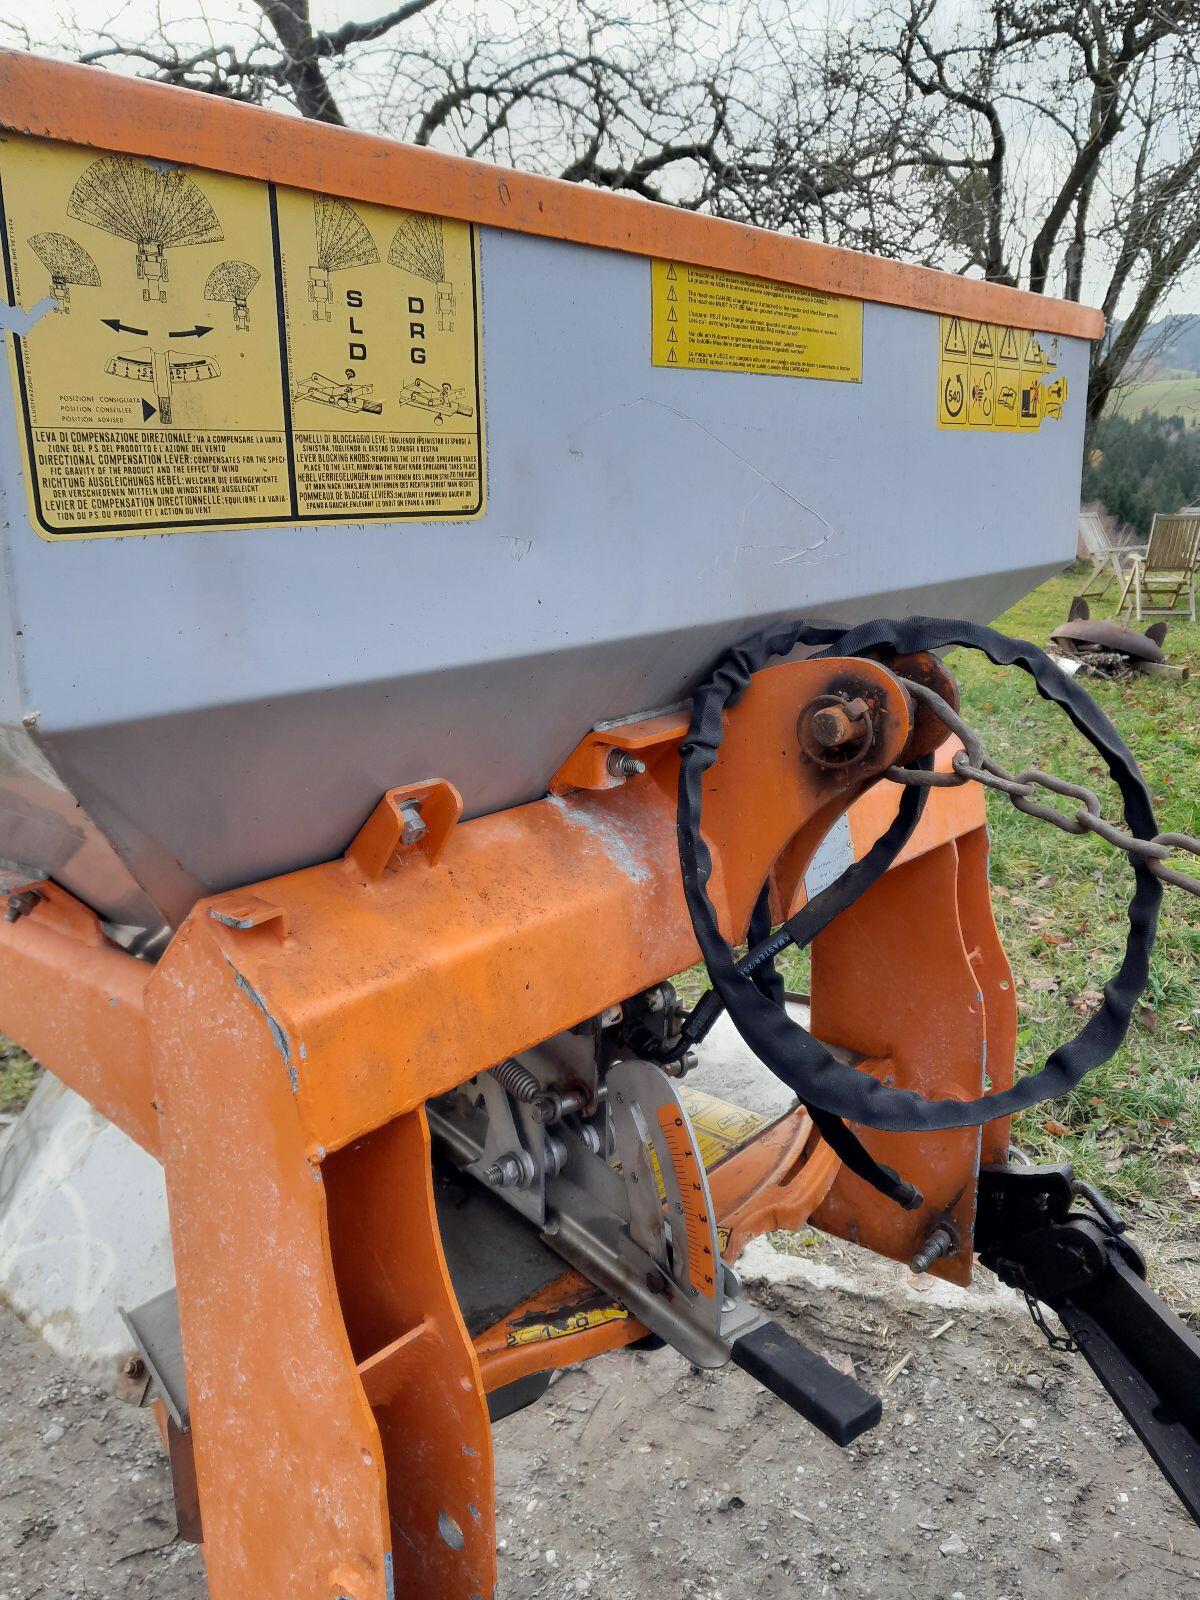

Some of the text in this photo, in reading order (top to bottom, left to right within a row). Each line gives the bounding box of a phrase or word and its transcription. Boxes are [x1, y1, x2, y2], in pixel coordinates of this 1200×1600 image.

[346, 290, 363, 308] S
[408, 296, 425, 314] D
[349, 316, 363, 334] L
[410, 322, 425, 339] R
[349, 342, 367, 361] D
[410, 347, 426, 365] G
[59, 395, 141, 404] POSIZIONE CONSIGLIATA
[947, 389, 961, 405] 540
[60, 405, 132, 414] POSITION CONSEILLEE
[61, 415, 124, 424] POSITION ADVISED
[35, 431, 57, 443] LEVA
[59, 432, 68, 443] DI
[70, 432, 139, 443] COMPENSAZIONE
[212, 436, 254, 444] COMPENSARE
[255, 436, 264, 444] LA
[294, 434, 323, 444] POMELLI
[324, 434, 331, 444] DI
[332, 434, 370, 444] BLOCCAGGIO
[48, 444, 70, 452] ZIONE
[72, 445, 85, 453] DEL
[116, 445, 152, 453] PRODOTTO
[204, 445, 226, 453] VENTO
[38, 454, 96, 466] DIRECTIONAL
[98, 455, 162, 466] COMPENSATION
[194, 456, 241, 464] COMPENSATES
[242, 456, 255, 464] FOR
[256, 456, 267, 464] THE
[296, 453, 317, 463] LEVER
[318, 453, 349, 463] BLOCKING
[50, 465, 239, 475] FIC GRAVITY OF THE PRODUCT AND THE EFFECT OF WIND
[42, 477, 86, 488] RICHTUNG
[88, 476, 155, 488] AUSGLEICHUNGS
[185, 476, 216, 485] WELCHER
[52, 489, 67, 498] DER
[68, 489, 126, 498] VERSCHIEDENEN
[127, 487, 158, 496] MITTELN
[160, 487, 174, 495] UND
[221, 484, 259, 493] AUSGLEICHT
[299, 491, 335, 501] POMMEAUX
[335, 491, 343, 500] DE
[344, 491, 370, 500] BLOCAGE
[45, 499, 75, 511] LEVIER
[77, 499, 88, 510] DE
[91, 497, 155, 509] COMPENSATION
[258, 495, 267, 503] LA
[57, 512, 75, 521] TION
[77, 512, 86, 520] DU
[101, 511, 112, 519] DU
[113, 509, 142, 518] PRODUIT
[144, 509, 153, 517] ET
[195, 506, 212, 515] VENT
[674, 1117, 683, 1127] 0
[684, 1149, 693, 1158] 1
[692, 1182, 702, 1192] 2
[698, 1213, 708, 1223] 3
[702, 1245, 711, 1255] 4
[704, 1275, 714, 1285] 5
